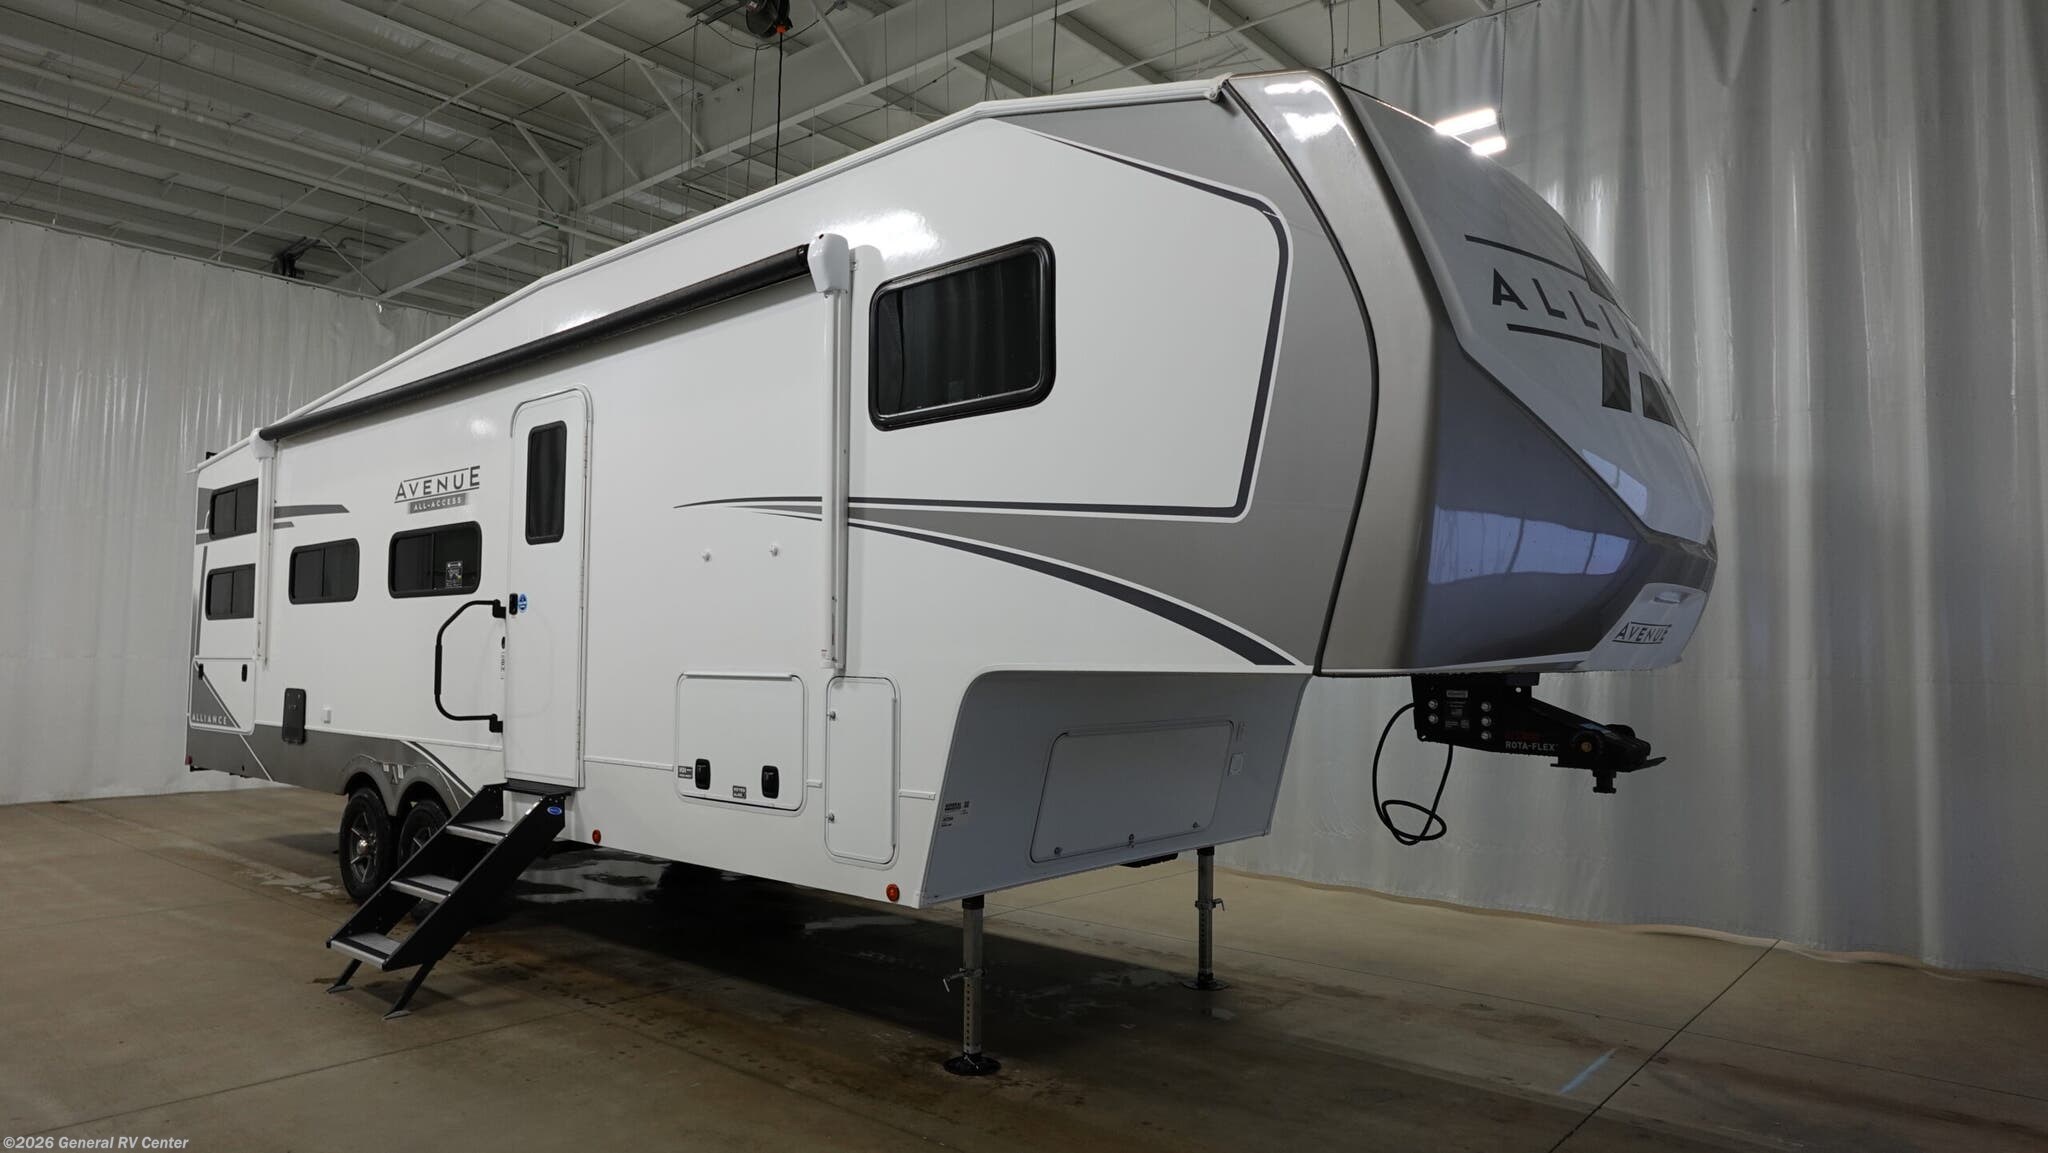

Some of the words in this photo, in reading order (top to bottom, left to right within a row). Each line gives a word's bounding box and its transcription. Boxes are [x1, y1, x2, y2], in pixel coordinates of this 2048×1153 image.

[395, 465, 480, 500] AVENUE
[1614, 622, 1669, 642] AVENUE
[191, 713, 228, 725] ALLIANCE
[1504, 740, 1556, 752] ROTA-FLEX
